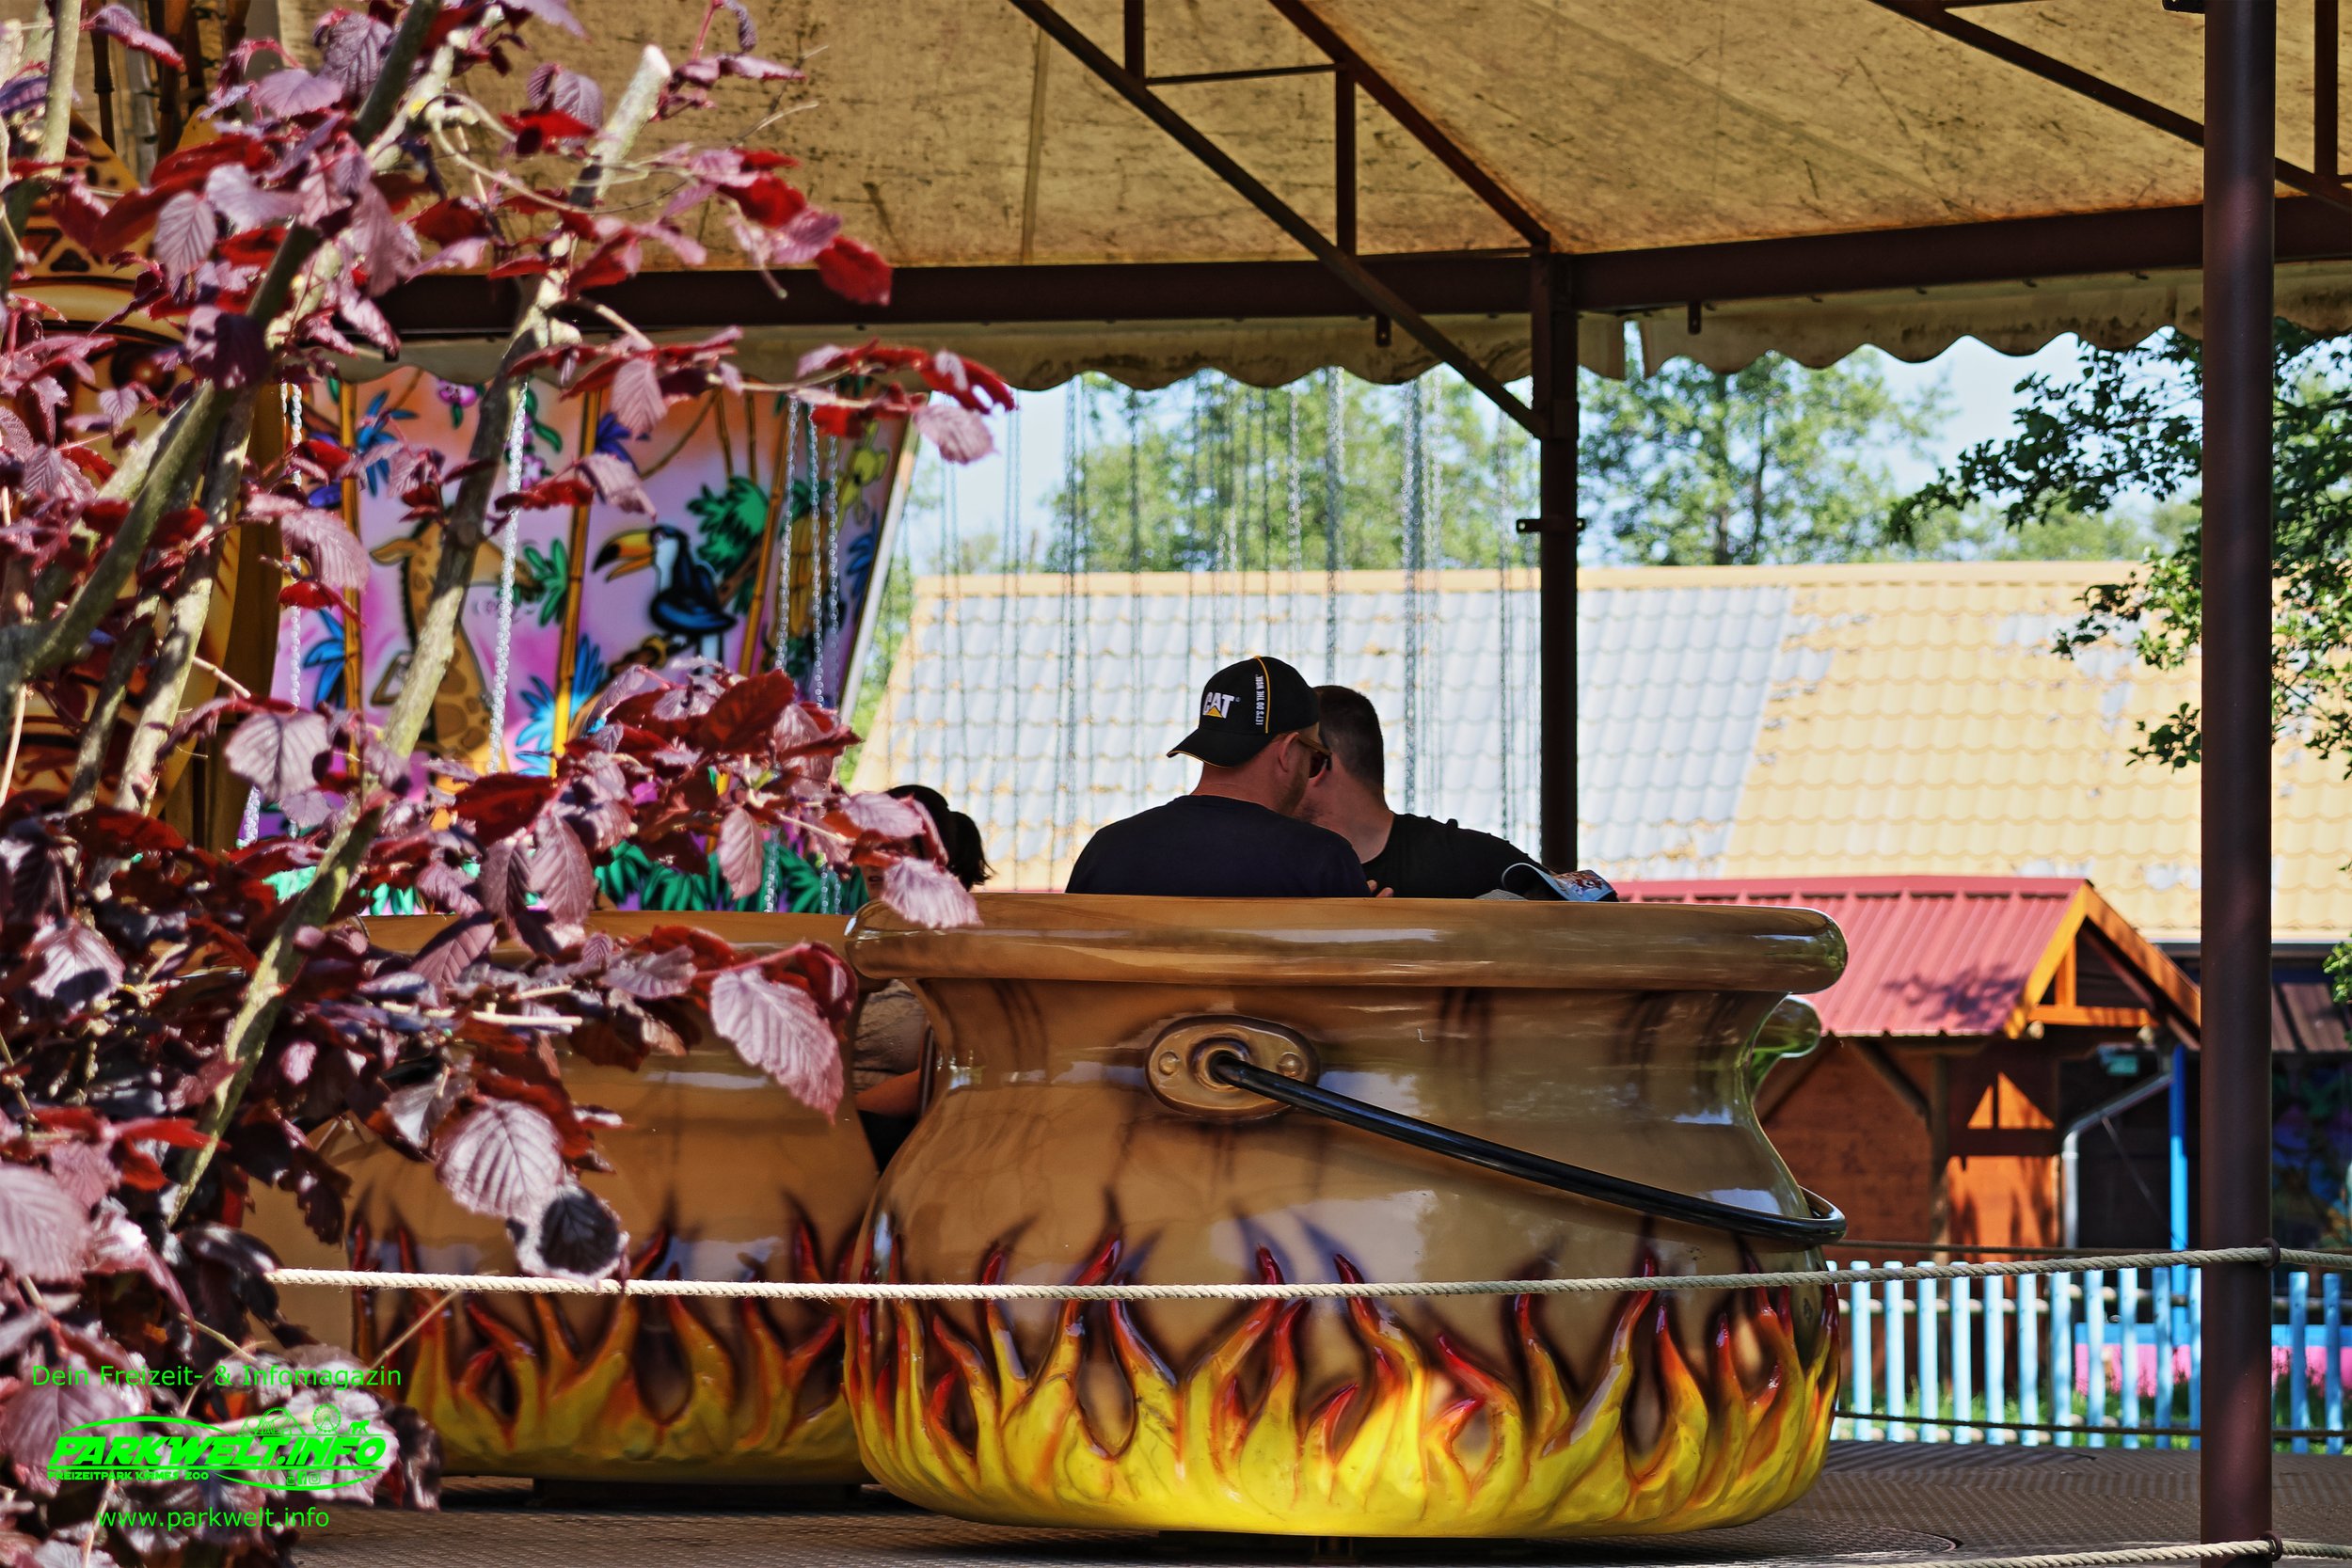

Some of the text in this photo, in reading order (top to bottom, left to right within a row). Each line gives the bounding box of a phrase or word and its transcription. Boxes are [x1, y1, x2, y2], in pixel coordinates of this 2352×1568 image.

[1203, 691, 1234, 719] CAT
[1255, 675, 1264, 725] LET'S DO THE WORK
